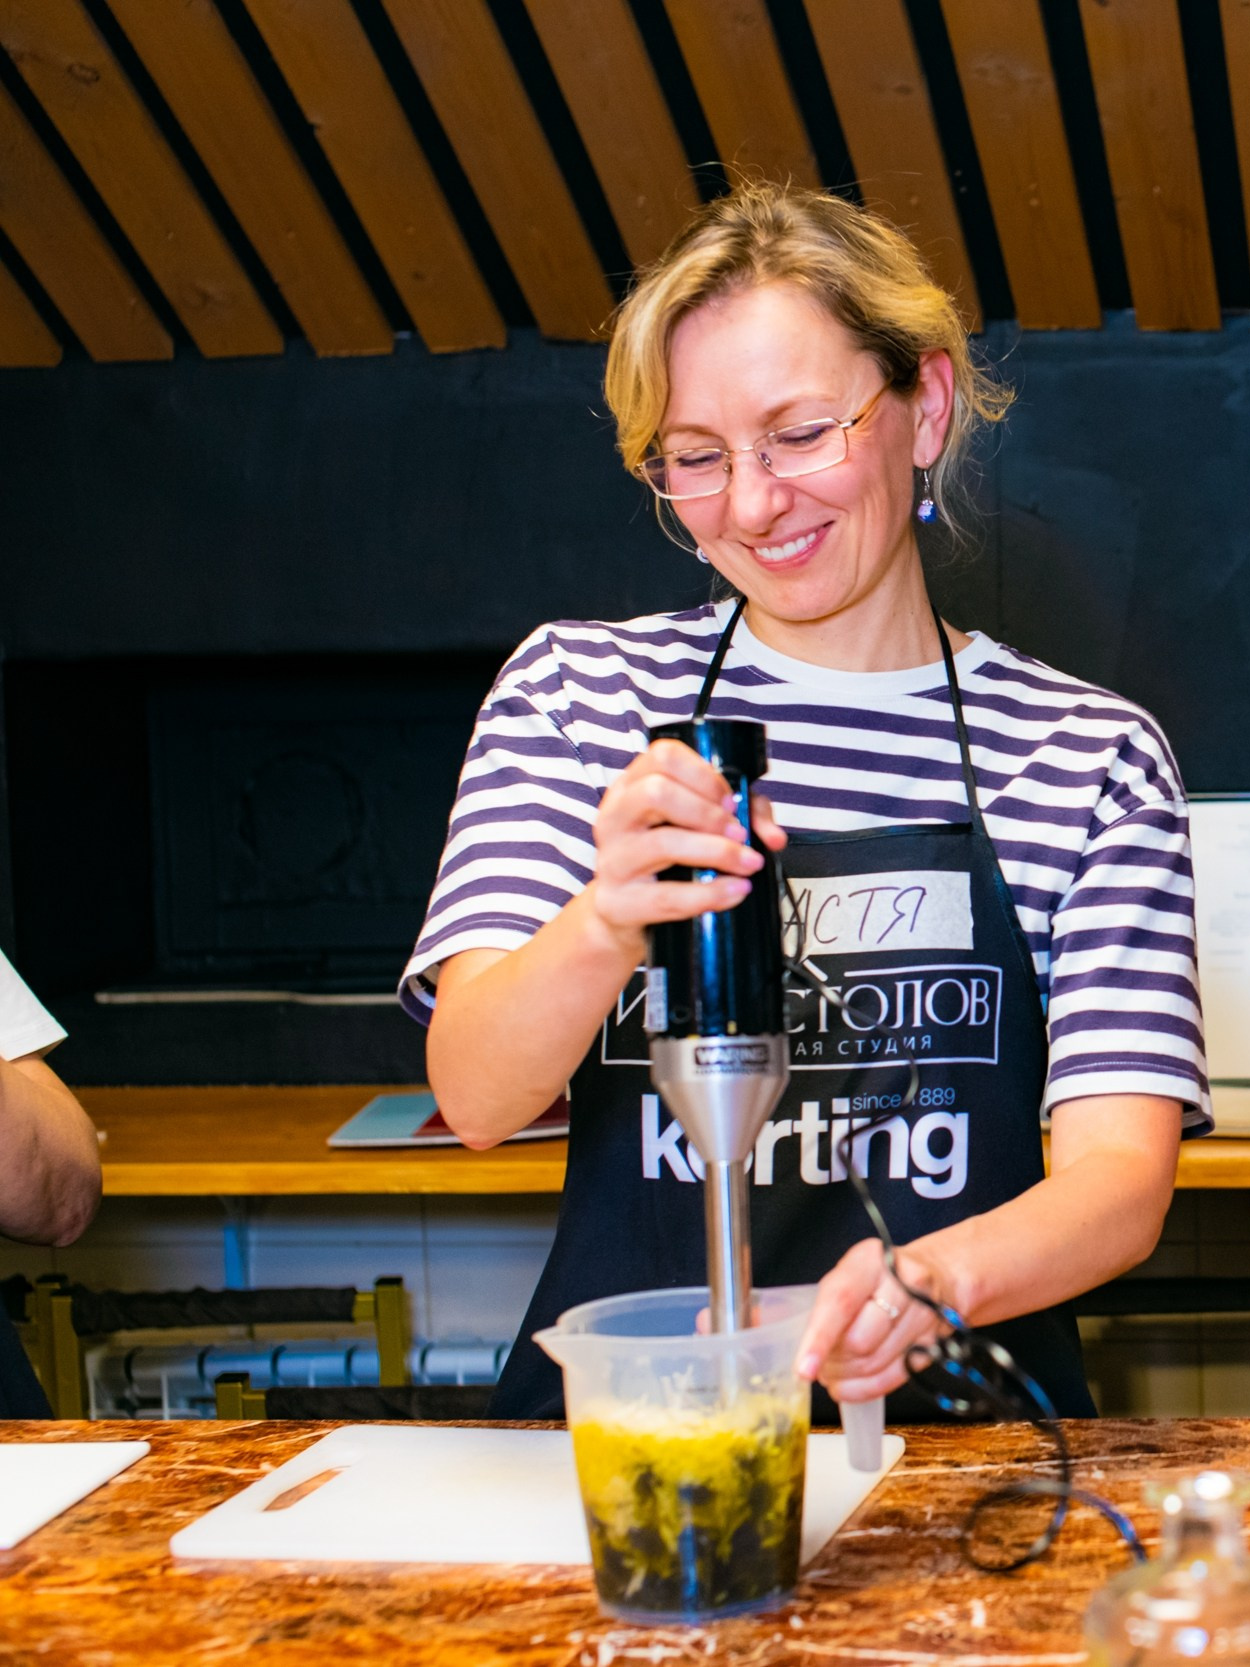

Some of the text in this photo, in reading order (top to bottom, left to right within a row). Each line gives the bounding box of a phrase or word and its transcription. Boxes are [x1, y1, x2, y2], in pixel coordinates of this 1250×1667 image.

[783, 886, 928, 944] АСТЯ
[837, 1034, 932, 1056] СТУДИЯ
[852, 1090, 901, 1111] since
[641, 1094, 970, 1199] krting
